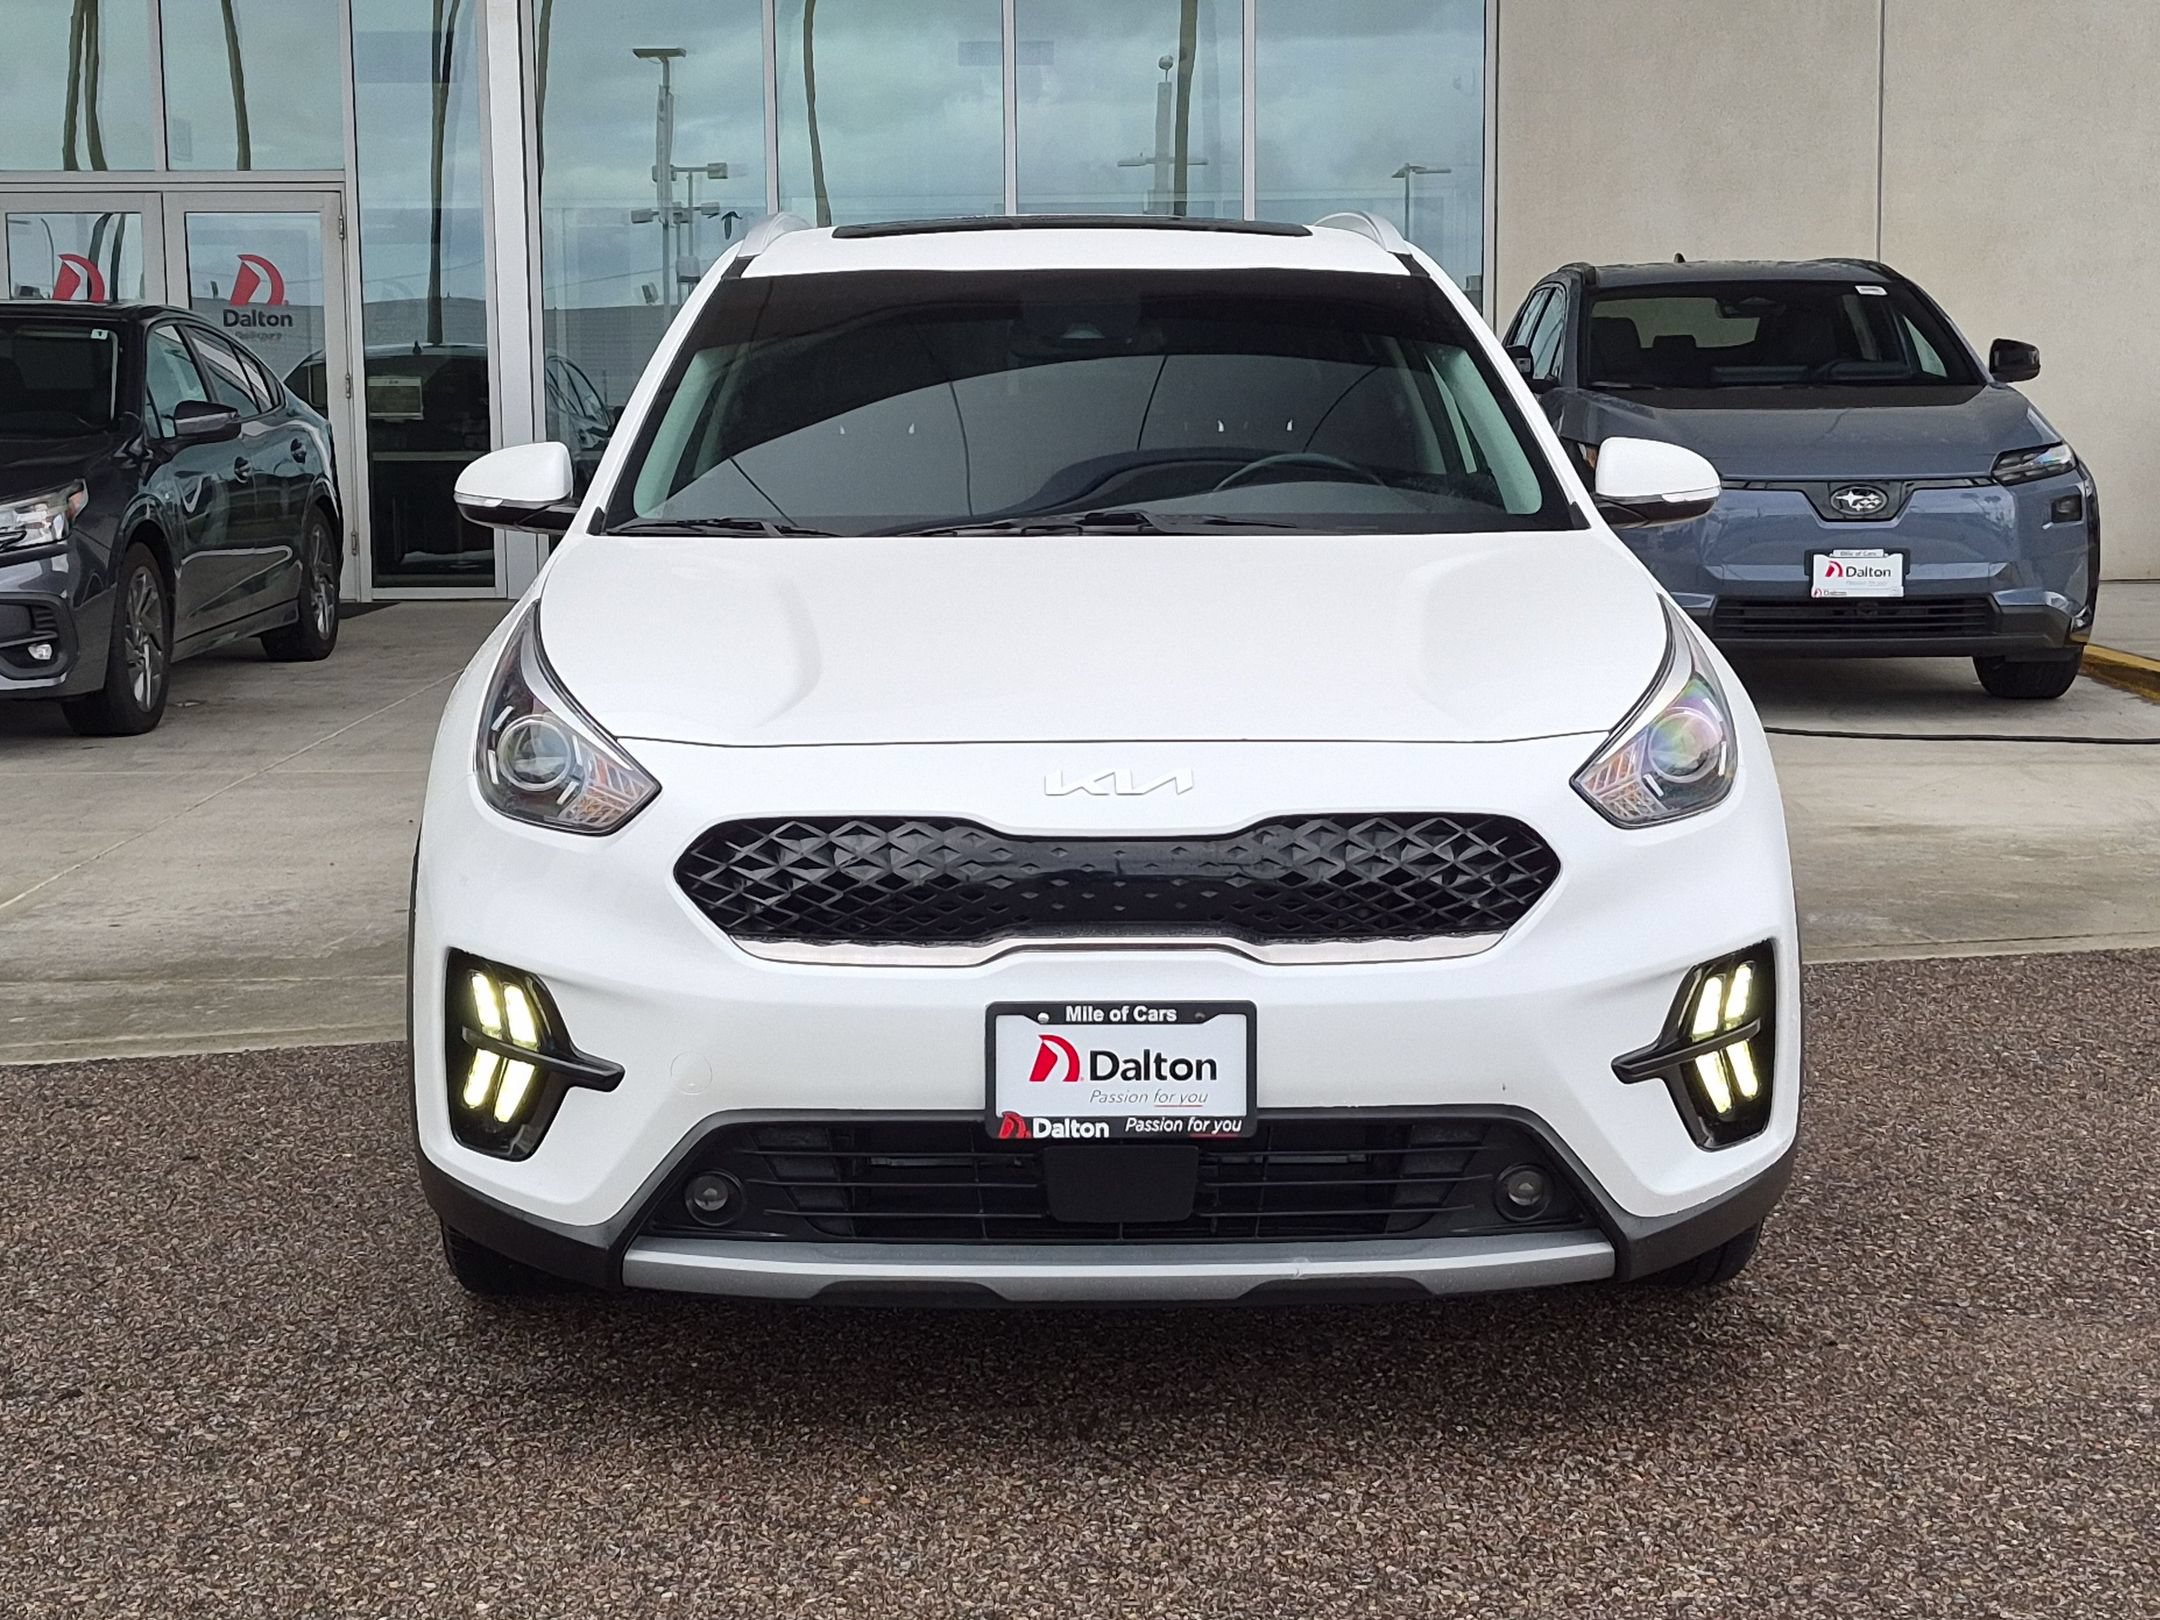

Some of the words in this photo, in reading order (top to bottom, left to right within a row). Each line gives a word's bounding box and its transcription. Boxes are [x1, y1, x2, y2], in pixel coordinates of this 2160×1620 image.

[223, 309, 293, 327] Dalton
[1846, 566, 1891, 578] Dalton
[1044, 768, 1193, 796] KIA
[1065, 1006, 1104, 1022] Mile
[1112, 1005, 1130, 1022] of
[1133, 1005, 1177, 1022] Cars
[1089, 1049, 1217, 1081] Dalton
[1089, 1089, 1148, 1103] Passion
[1153, 1089, 1176, 1103] for
[1177, 1093, 1208, 1106] you
[1033, 1118, 1110, 1138] Dalton
[1125, 1117, 1183, 1133] Passion
[1188, 1116, 1211, 1133] for
[1210, 1119, 1242, 1134] you
